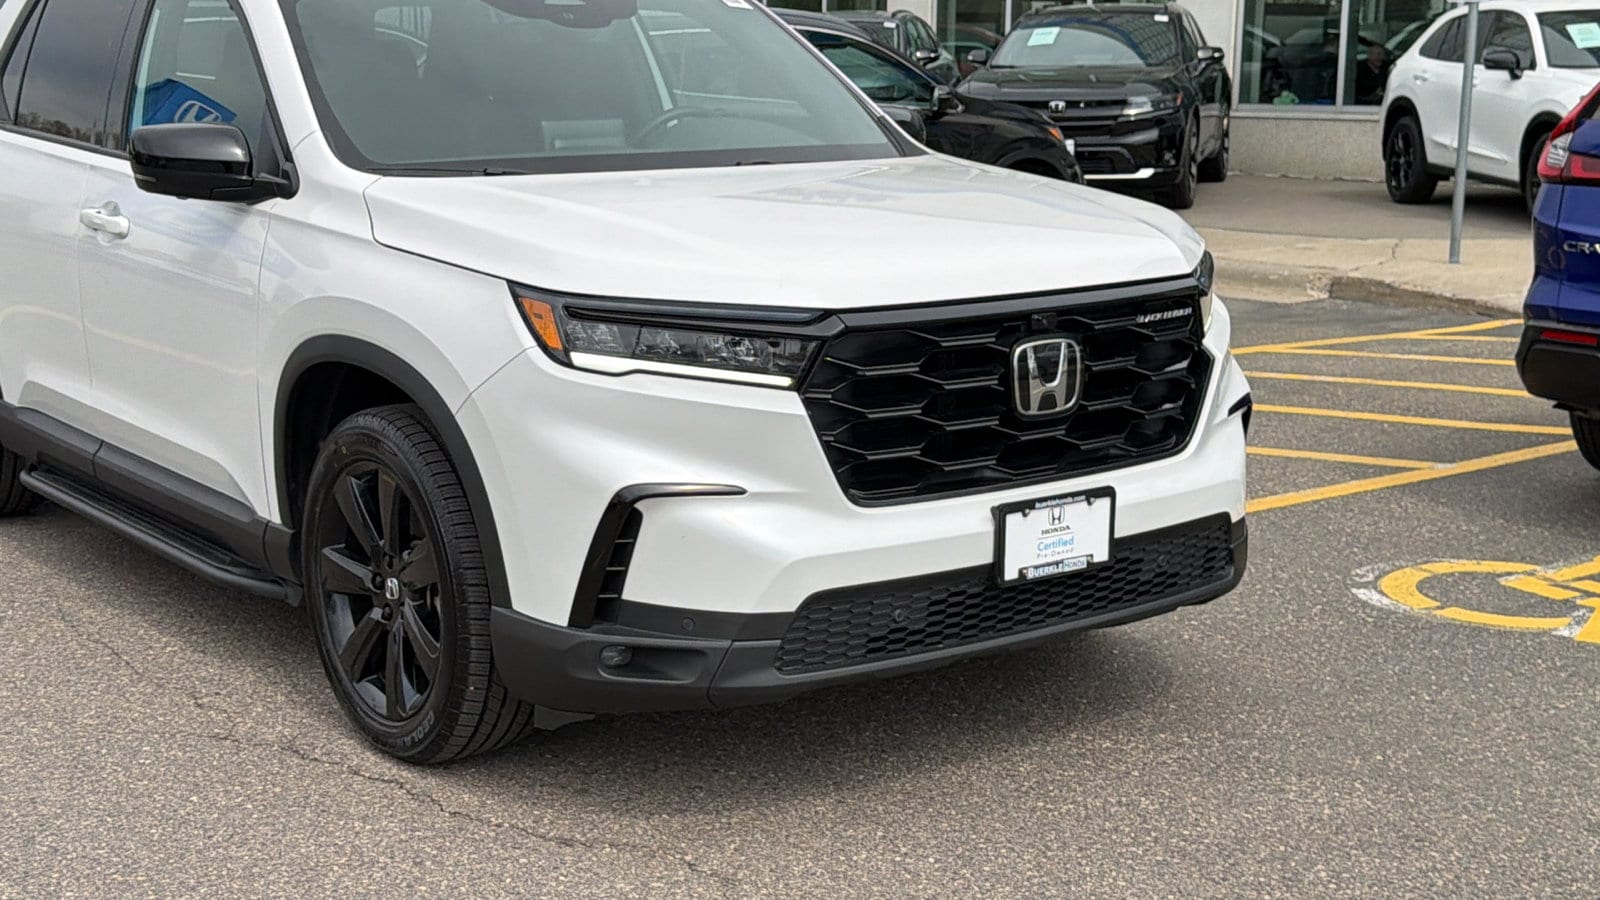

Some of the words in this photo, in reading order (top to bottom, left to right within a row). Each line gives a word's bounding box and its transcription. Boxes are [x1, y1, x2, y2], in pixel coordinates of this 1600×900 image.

[1041, 524, 1071, 535] HONDA
[1037, 536, 1074, 551] Certified
[1037, 548, 1074, 559] Pre-Owned
[1028, 564, 1063, 578] BUERKLE
[1063, 559, 1085, 570] HONDA
